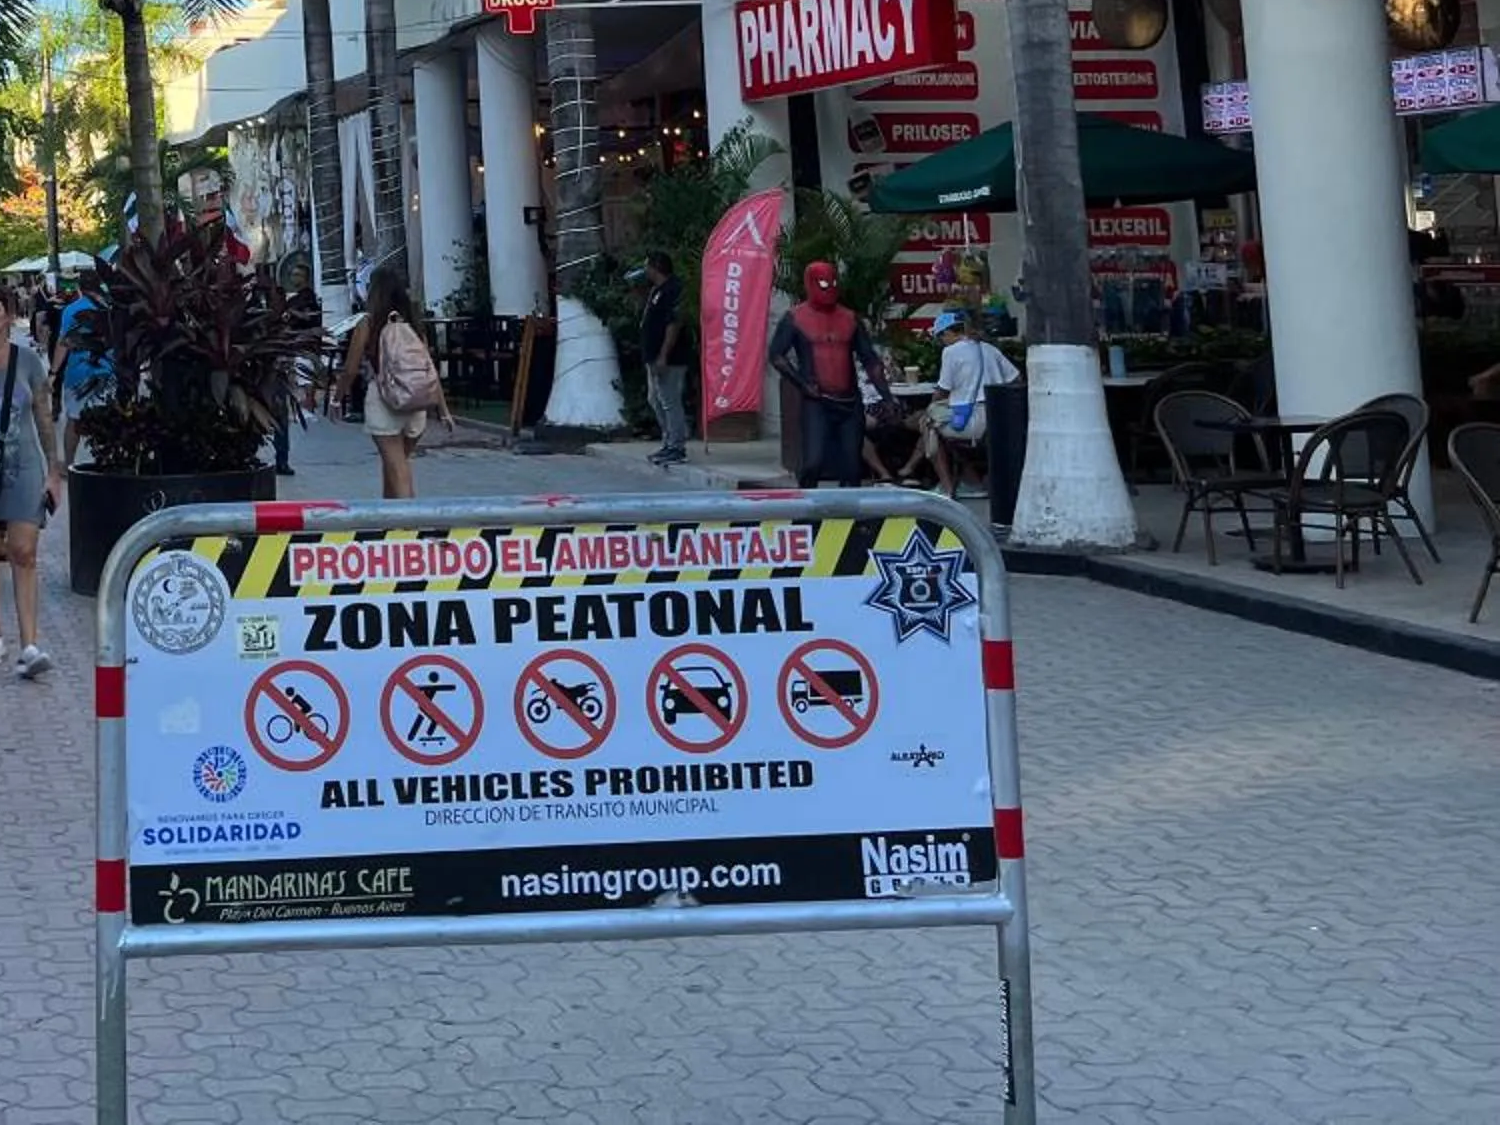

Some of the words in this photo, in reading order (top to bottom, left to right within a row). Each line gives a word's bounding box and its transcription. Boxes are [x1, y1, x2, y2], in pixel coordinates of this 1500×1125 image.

[1073, 71, 1154, 86] ESTOSTERONE
[892, 124, 971, 142] PRILOSEC
[1090, 218, 1168, 236] LEXERIL
[294, 539, 488, 581] PROHIBIDO
[501, 538, 543, 572] EL
[555, 528, 811, 572] AMBULANTAJE
[303, 600, 476, 652] ZONA
[493, 586, 815, 644] PEATONAL
[320, 780, 385, 809] ALL
[392, 771, 575, 805] VEHICLES
[585, 760, 814, 797] PROHIBITED
[519, 806, 542, 821] DE
[629, 797, 720, 817] MUNICIPAL
[143, 822, 302, 846] SOLIDARIDAD
[861, 834, 968, 876] Nasim
[205, 870, 347, 902] MANDARINA'S
[357, 867, 413, 893] CAFE
[501, 861, 782, 900] nasimgroup.com
